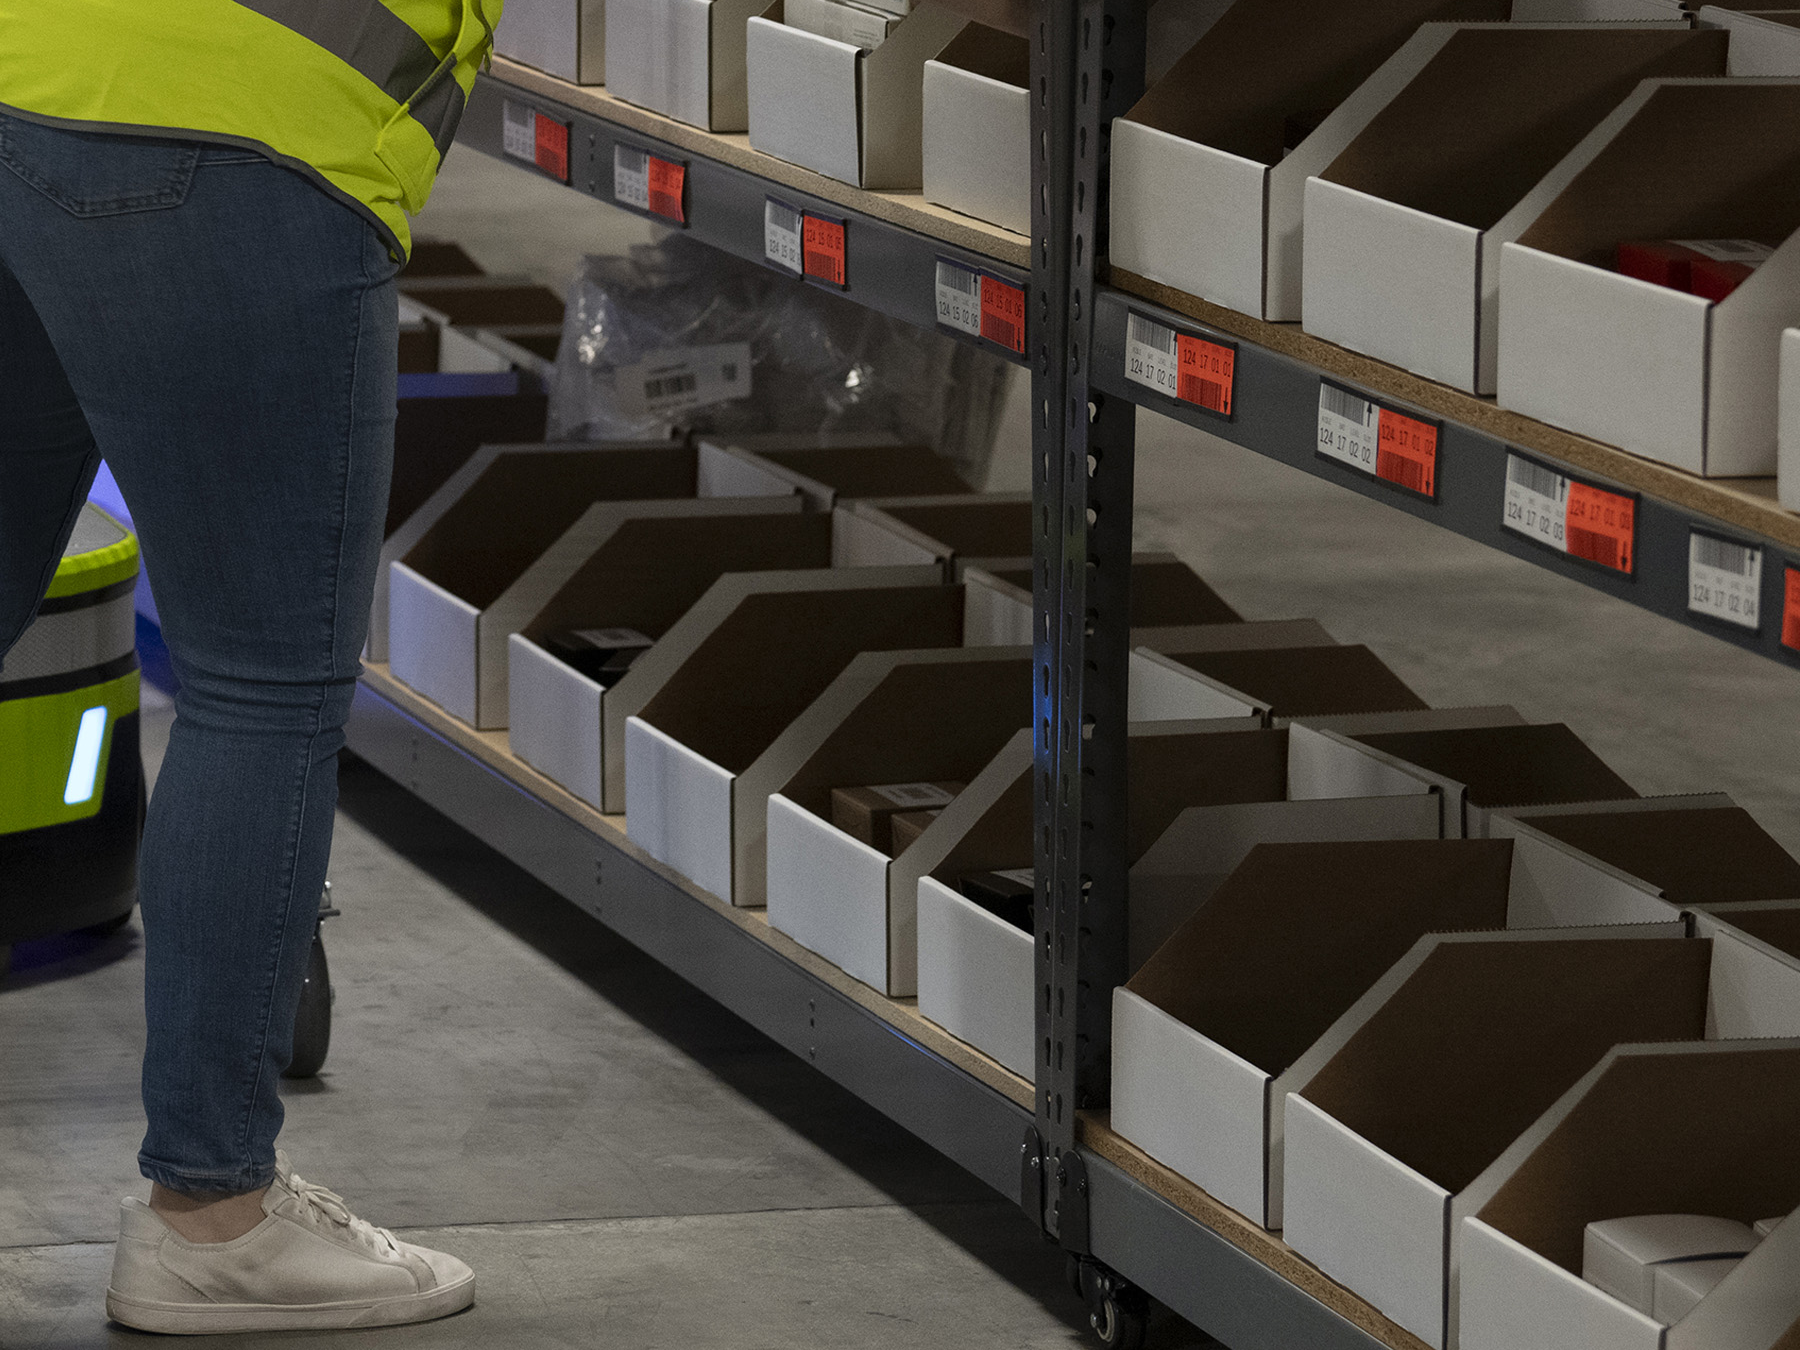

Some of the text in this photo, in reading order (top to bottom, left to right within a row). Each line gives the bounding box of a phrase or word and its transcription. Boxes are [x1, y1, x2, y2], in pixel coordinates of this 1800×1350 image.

[939, 300, 979, 329] 124 15 02 06
[984, 288, 1023, 319] 124 15 01 06
[1130, 357, 1143, 376] 124
[1145, 364, 1154, 380] 17
[1157, 368, 1166, 386] 02
[1168, 373, 1176, 391] 01
[1183, 348, 1196, 366] 124
[1200, 354, 1209, 369] 17
[1211, 357, 1220, 374] 01
[1223, 361, 1232, 378] 01
[1320, 427, 1333, 447] 124
[1337, 434, 1347, 452] 17
[1349, 440, 1359, 459] 02
[1361, 445, 1371, 465] 02
[1382, 424, 1395, 443] 124
[1399, 430, 1409, 447] 17
[1412, 434, 1420, 452] 01
[1424, 438, 1434, 457] 02
[1508, 501, 1522, 521] 124
[1526, 508, 1536, 527] 17
[1540, 515, 1550, 535] 02
[1553, 521, 1564, 541] 03
[1570, 498, 1585, 517] 124
[1590, 504, 1600, 522] 17
[1604, 507, 1615, 527] 01
[1694, 583, 1709, 604] 124
[1714, 589, 1725, 608] 17
[1728, 593, 1740, 614] 02
